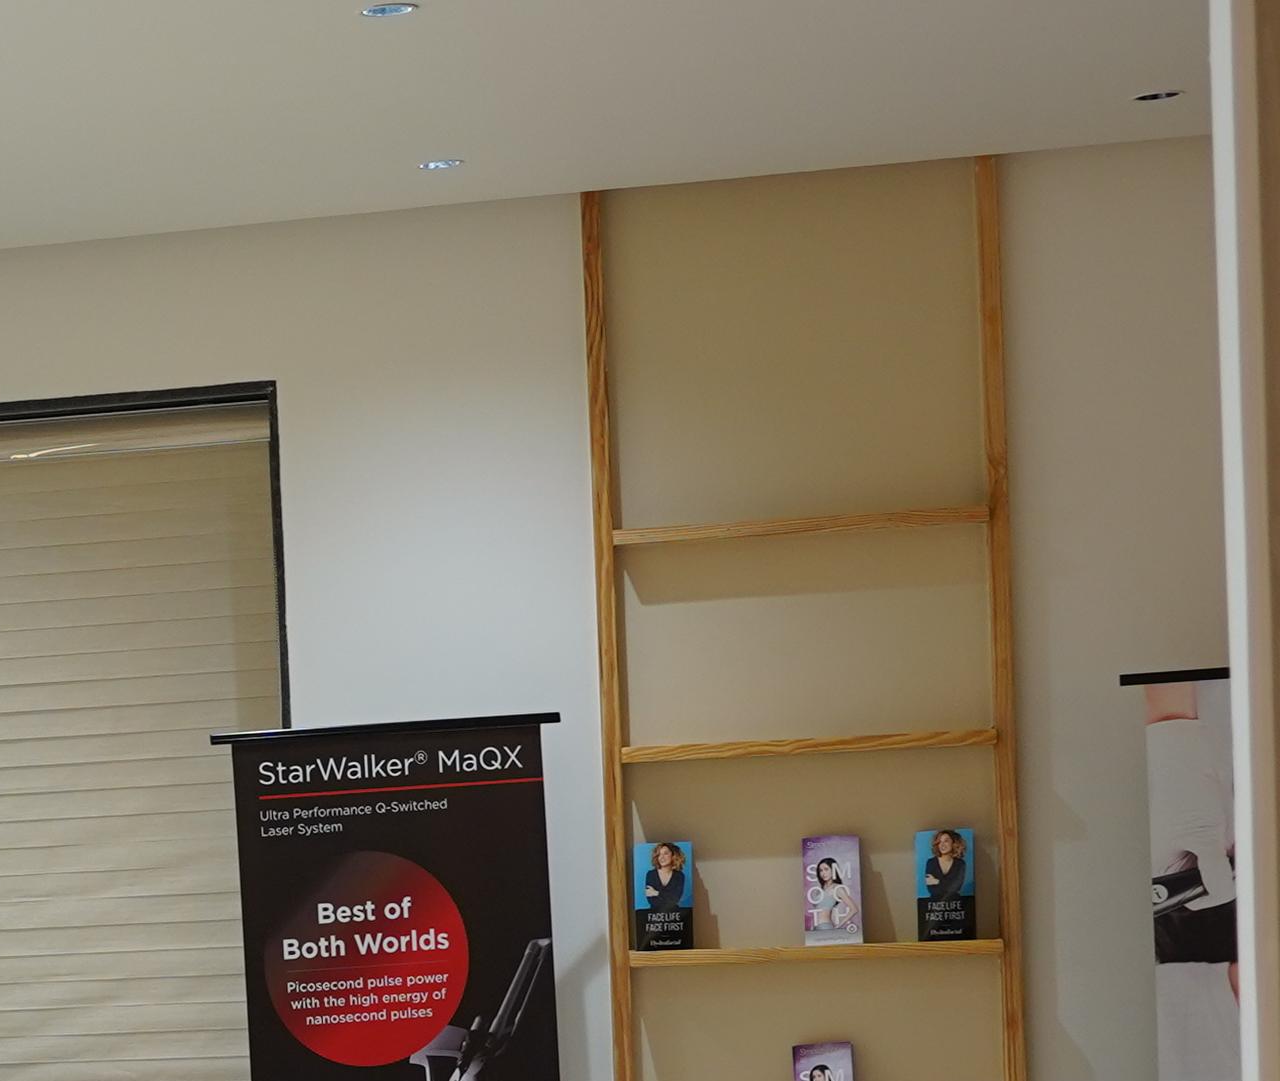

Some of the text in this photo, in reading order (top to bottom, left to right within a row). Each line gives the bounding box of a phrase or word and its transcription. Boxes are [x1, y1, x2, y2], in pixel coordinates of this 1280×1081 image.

[438, 745, 523, 774] MaQX
[259, 799, 448, 822] Ultra Performance Q-Switched
[261, 822, 343, 837] Laser System
[317, 896, 412, 925] Best of
[283, 928, 449, 960] Both Worlds
[287, 973, 449, 994] Picosecond pulse power
[291, 987, 447, 1010] with the high energy of
[306, 1007, 433, 1026] nanosecond pulses
